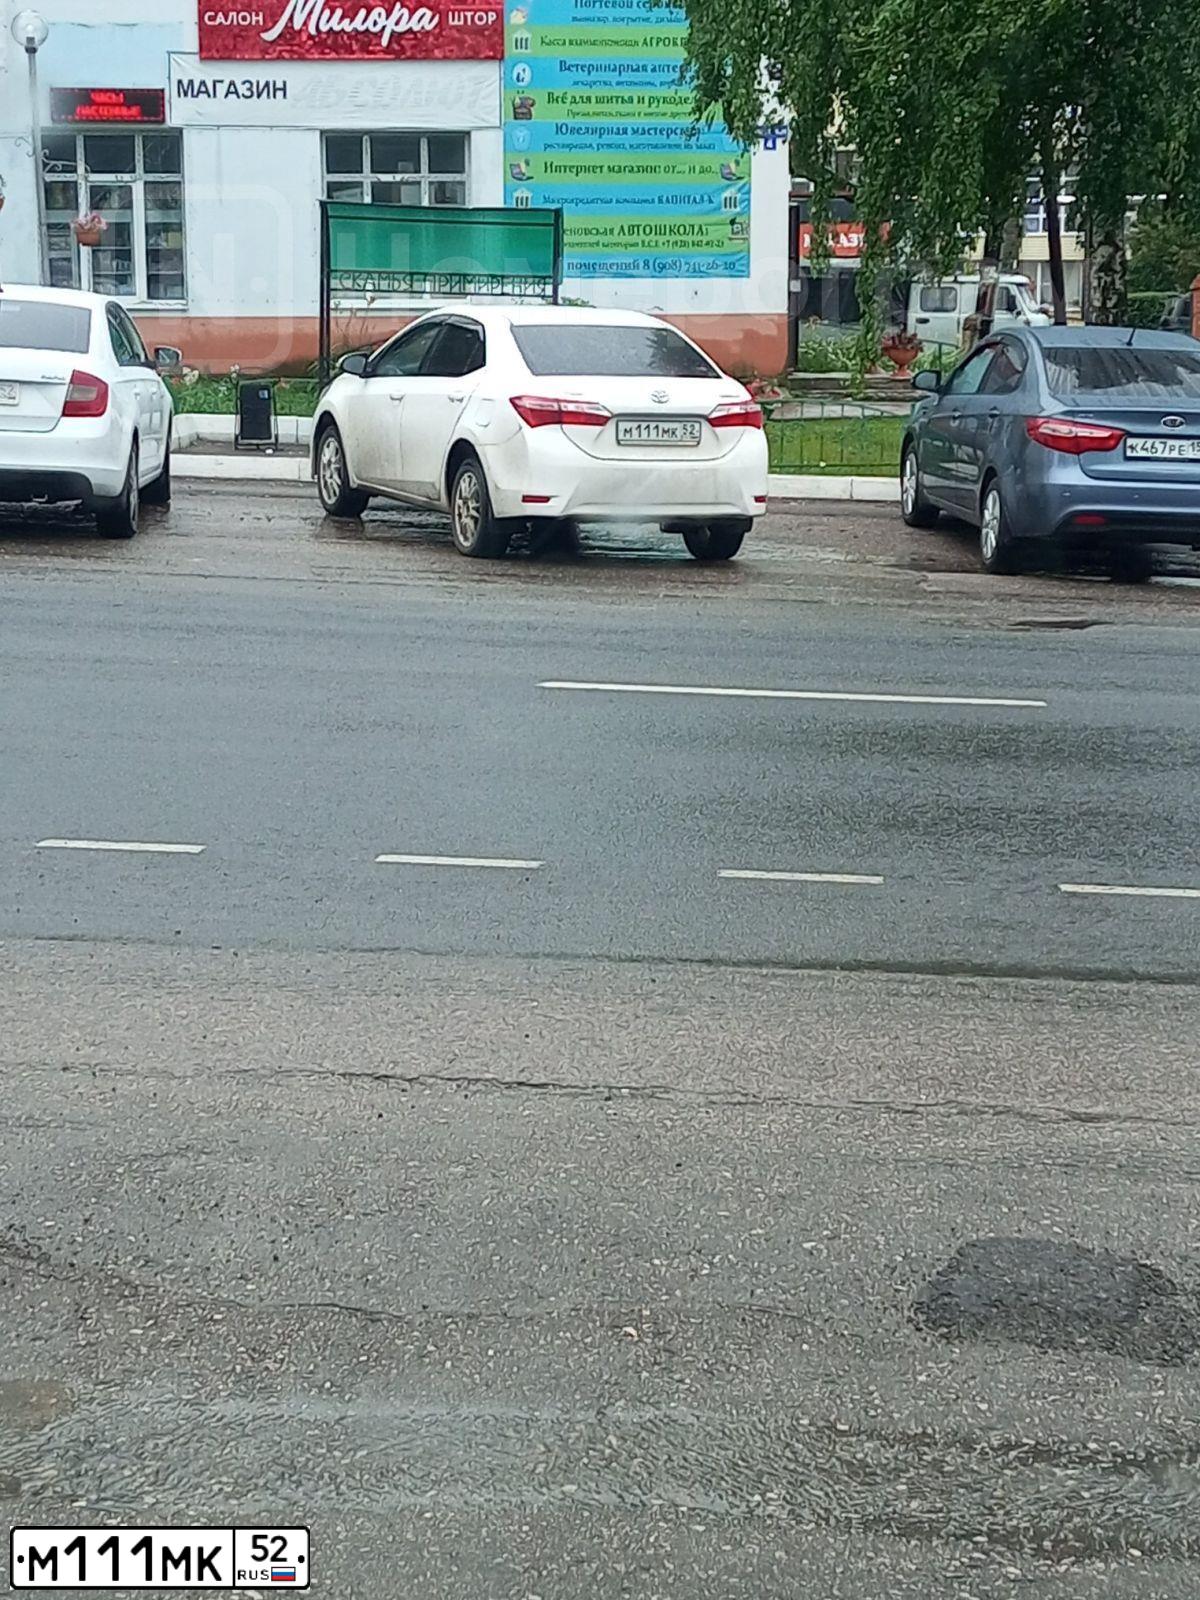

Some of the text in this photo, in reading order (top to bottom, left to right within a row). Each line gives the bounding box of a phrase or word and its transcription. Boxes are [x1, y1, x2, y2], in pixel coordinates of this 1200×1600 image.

[204, 0, 497, 47] САЛОН Милора ШТОР
[559, 60, 649, 77] Ветеринарная
[177, 79, 288, 100] МАГАЗИН
[569, 96, 593, 106] для
[595, 96, 634, 105] шитья
[555, 122, 628, 138] Ювелирная
[544, 161, 604, 177] Интернет
[642, 259, 650, 269] 8
[339, 272, 414, 290] СКАМЬЯ
[683, 424, 696, 435] 52
